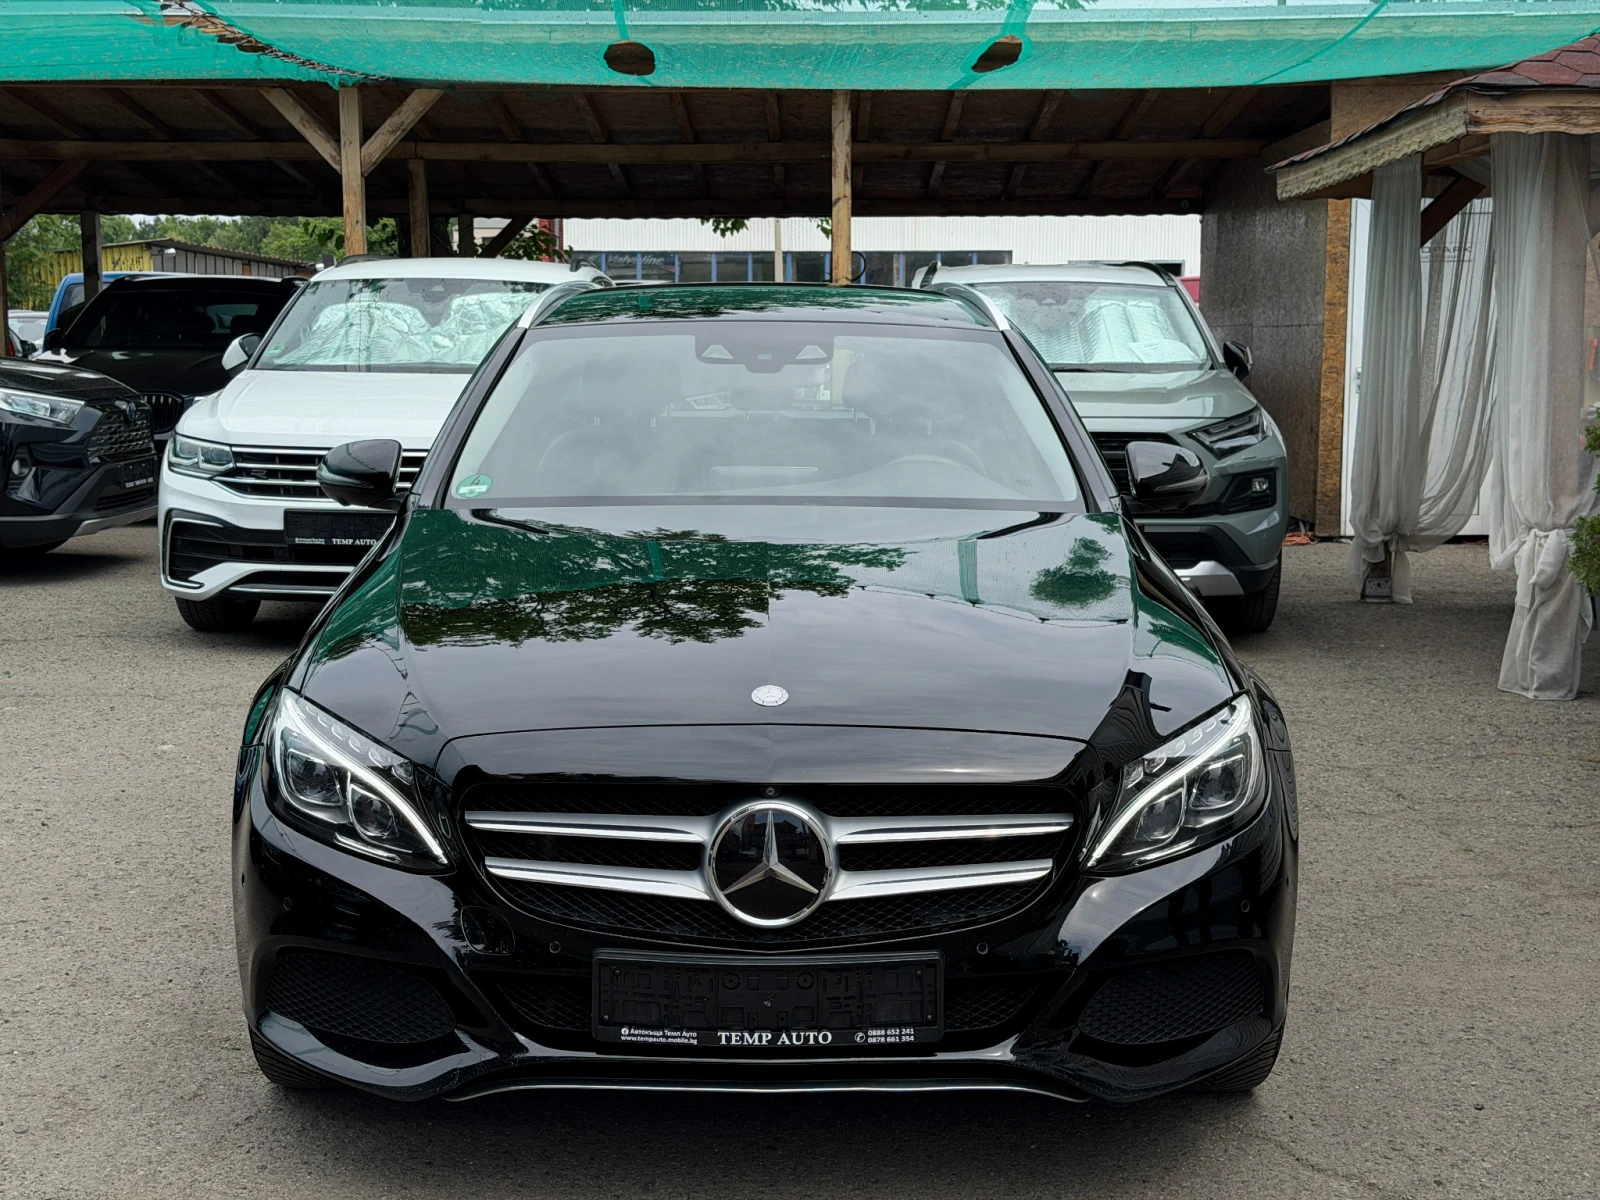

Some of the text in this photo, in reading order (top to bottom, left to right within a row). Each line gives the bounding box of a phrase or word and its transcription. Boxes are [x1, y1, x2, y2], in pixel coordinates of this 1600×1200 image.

[607, 254, 665, 265] Valvline
[470, 475, 481, 486] 4
[887, 1028, 900, 1036] 652
[717, 1031, 833, 1045] TEMP AUTO
